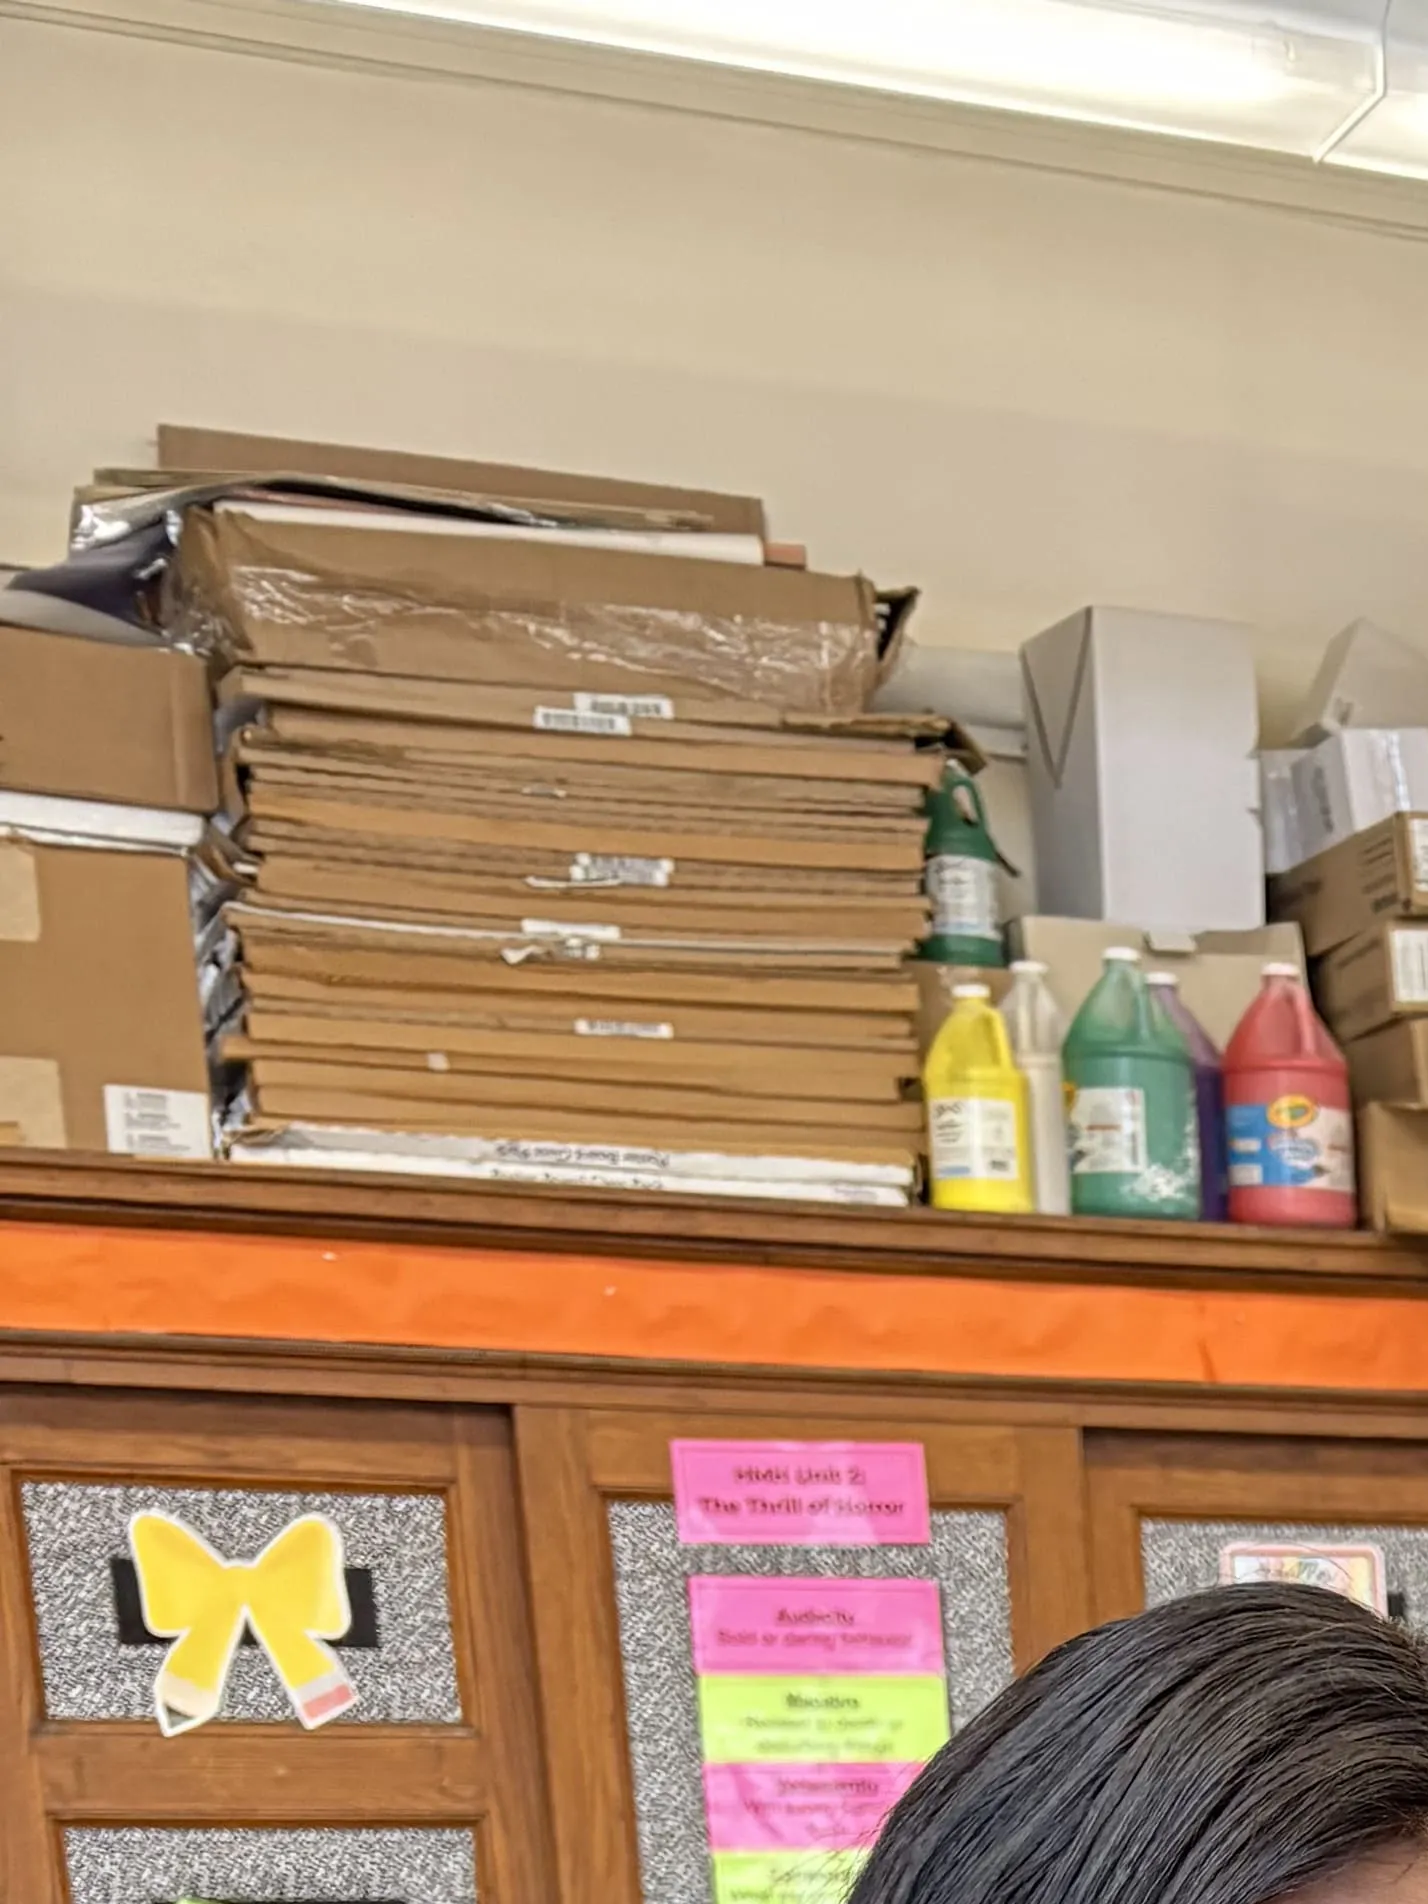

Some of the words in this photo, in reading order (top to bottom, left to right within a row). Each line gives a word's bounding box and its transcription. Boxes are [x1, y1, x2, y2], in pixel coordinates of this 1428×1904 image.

[700, 1497, 741, 1515] The
[747, 1497, 802, 1515] Thrill
[807, 1498, 829, 1516] of
